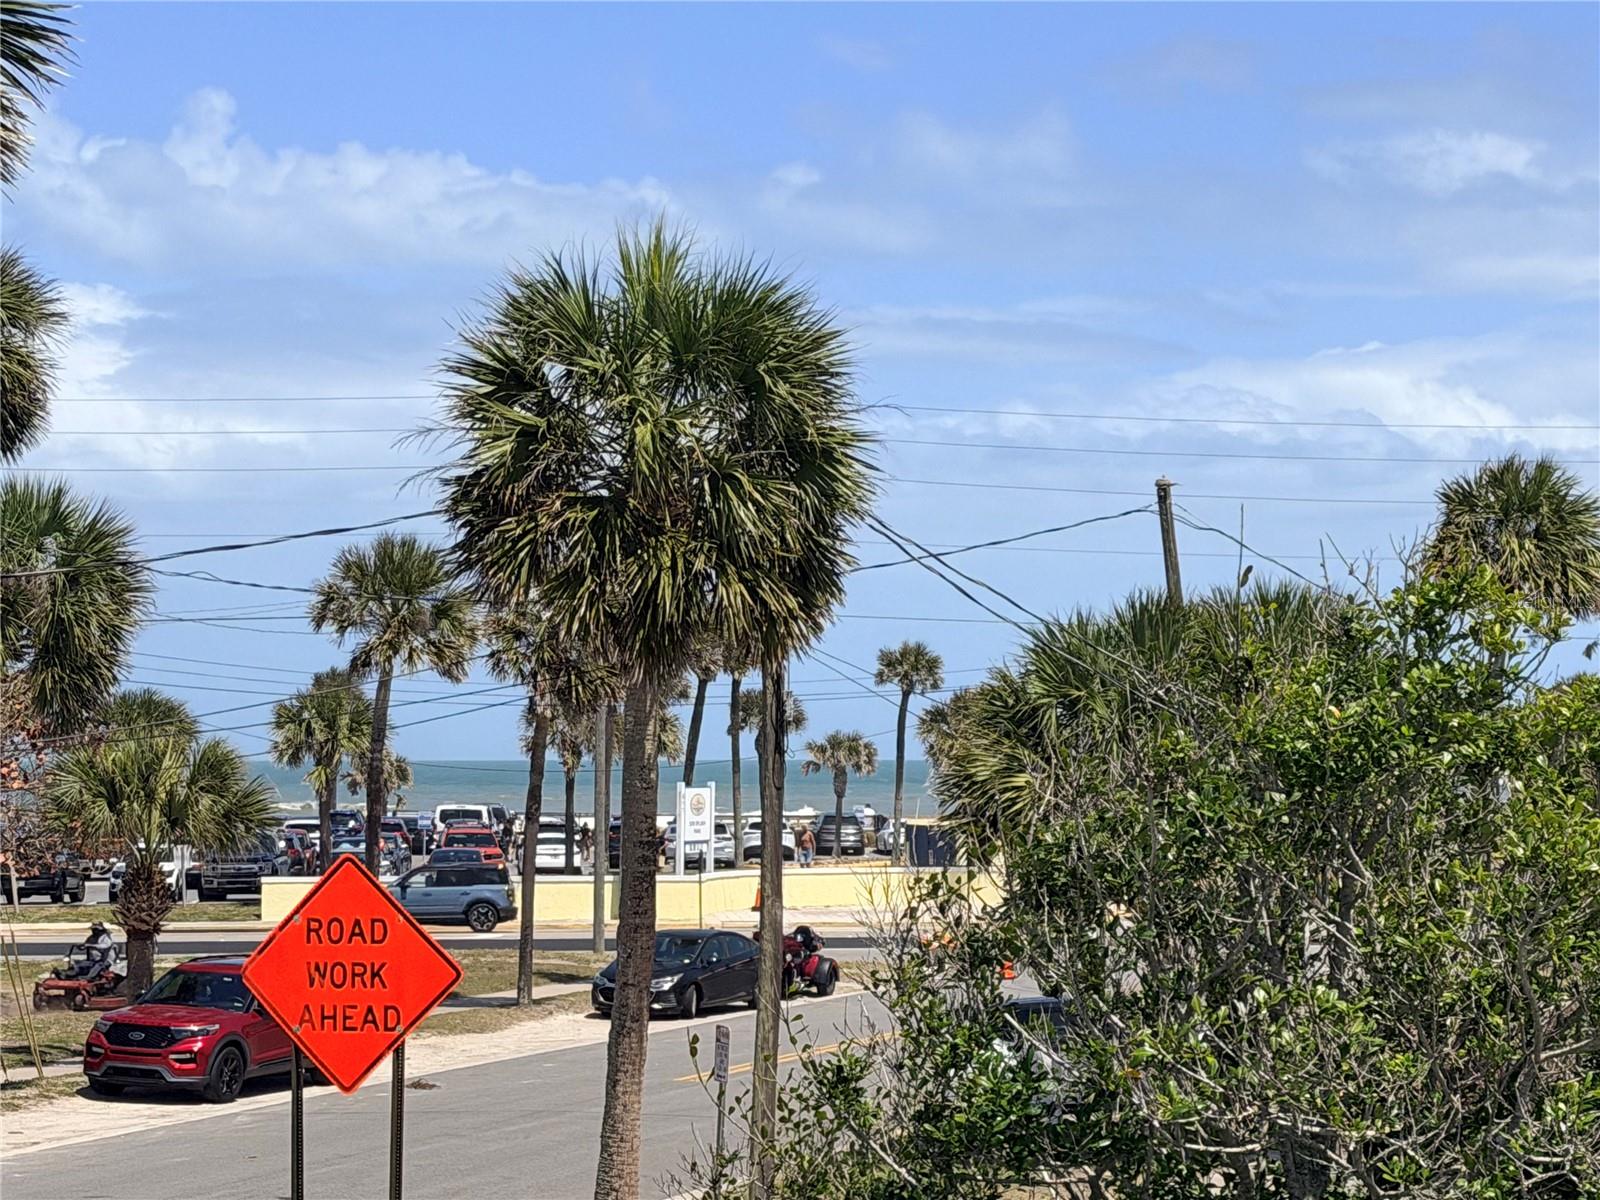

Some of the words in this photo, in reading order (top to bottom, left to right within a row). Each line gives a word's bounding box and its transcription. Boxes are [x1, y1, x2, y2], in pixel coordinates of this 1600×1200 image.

[306, 917, 388, 945] ROAD
[306, 961, 388, 989] WORK
[299, 1004, 401, 1032] AHEAD
